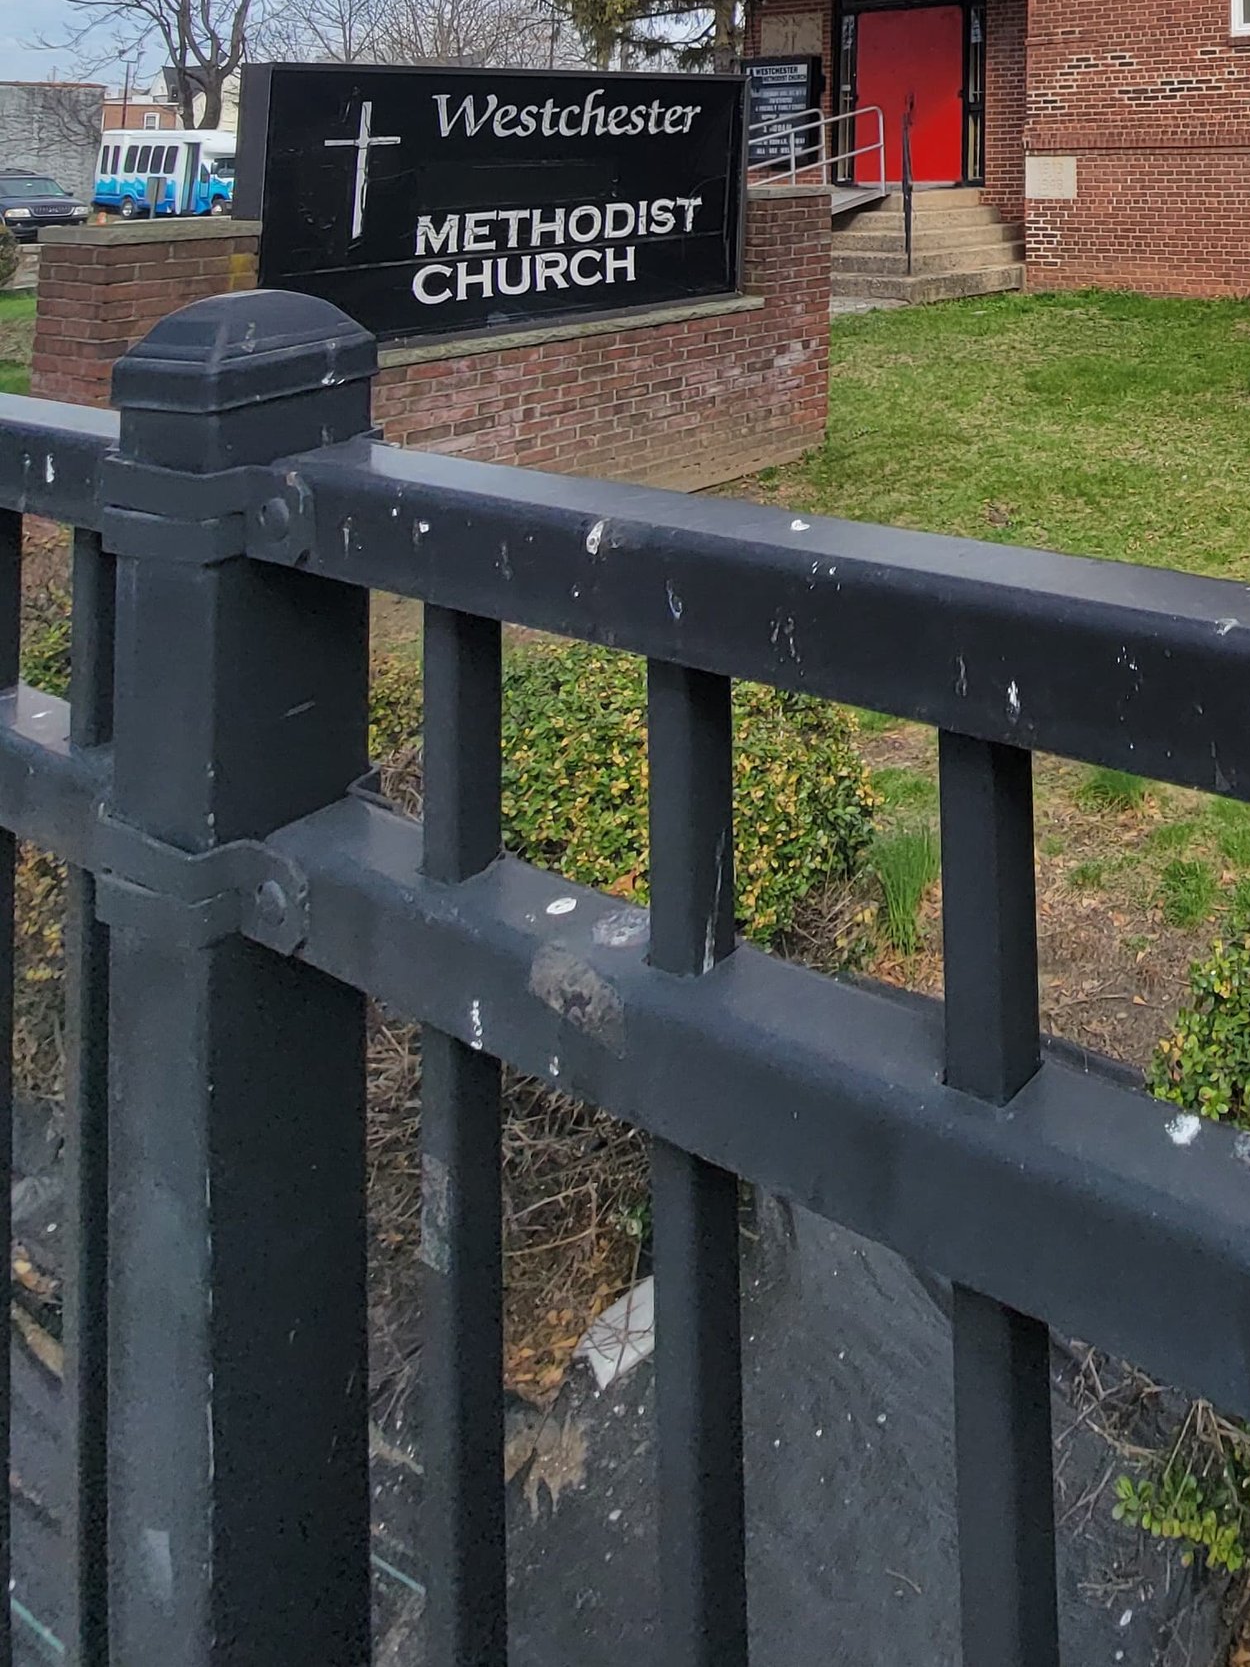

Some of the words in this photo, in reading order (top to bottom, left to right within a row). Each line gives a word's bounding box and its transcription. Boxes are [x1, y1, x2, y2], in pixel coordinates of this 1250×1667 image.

[756, 66, 799, 75] WESTCHESTER
[431, 89, 701, 137] Westchester
[415, 197, 702, 256] METHODIST
[412, 246, 636, 304] CHURCH
